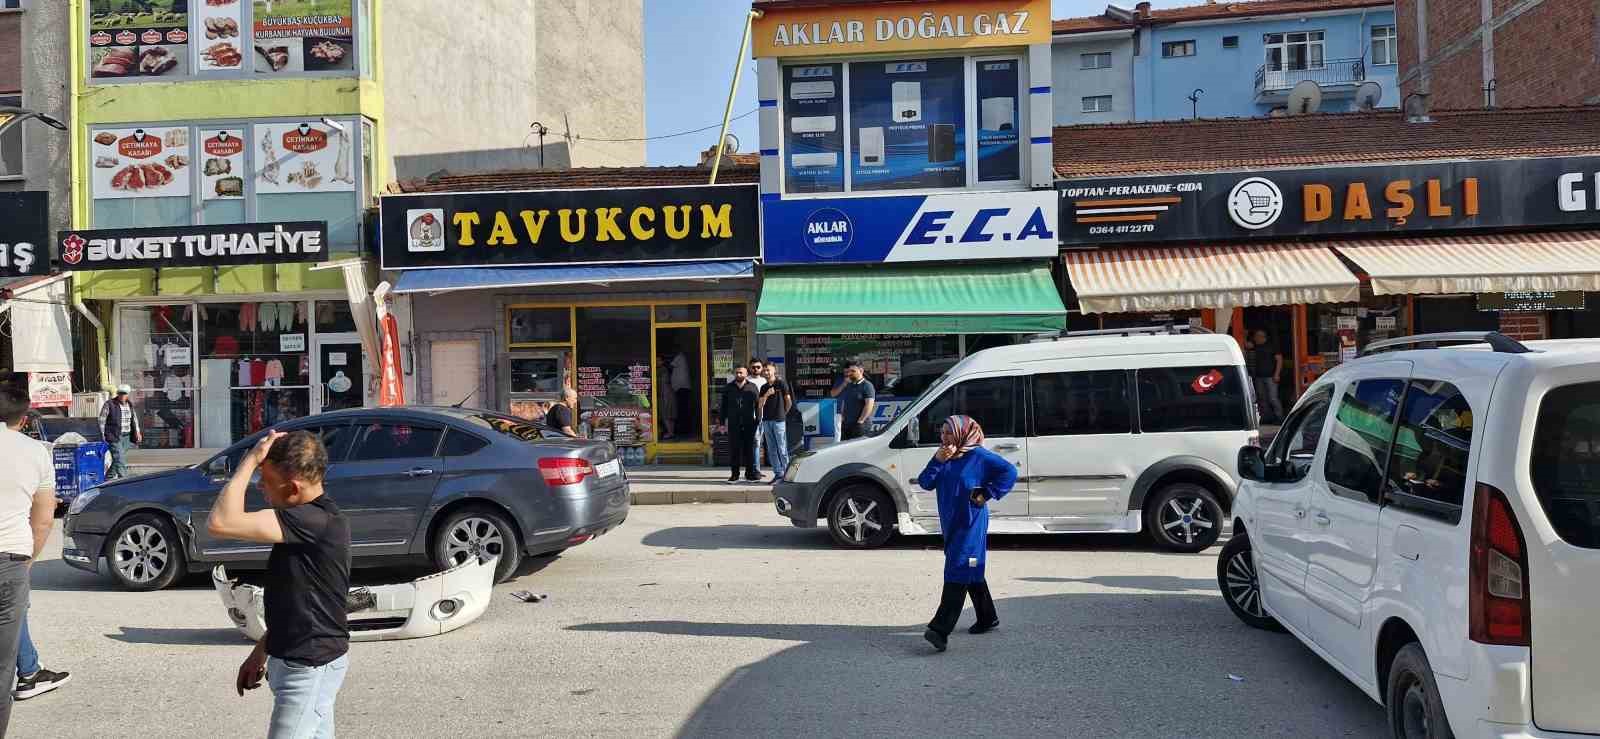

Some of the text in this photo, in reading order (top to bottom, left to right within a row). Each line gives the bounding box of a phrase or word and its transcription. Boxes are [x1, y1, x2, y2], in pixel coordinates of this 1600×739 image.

[774, 11, 1030, 46] AKLAR DOĞALGAZ
[1061, 182, 1203, 198] TOPTAN-PERAKENDE-GIDA
[1302, 176, 1480, 226] DAŞLI
[453, 203, 733, 246] TAVUKCUM
[807, 220, 848, 234] AKLAR
[1089, 225, 1114, 234] 0364
[87, 225, 321, 261] BUKET TUHAFİYE
